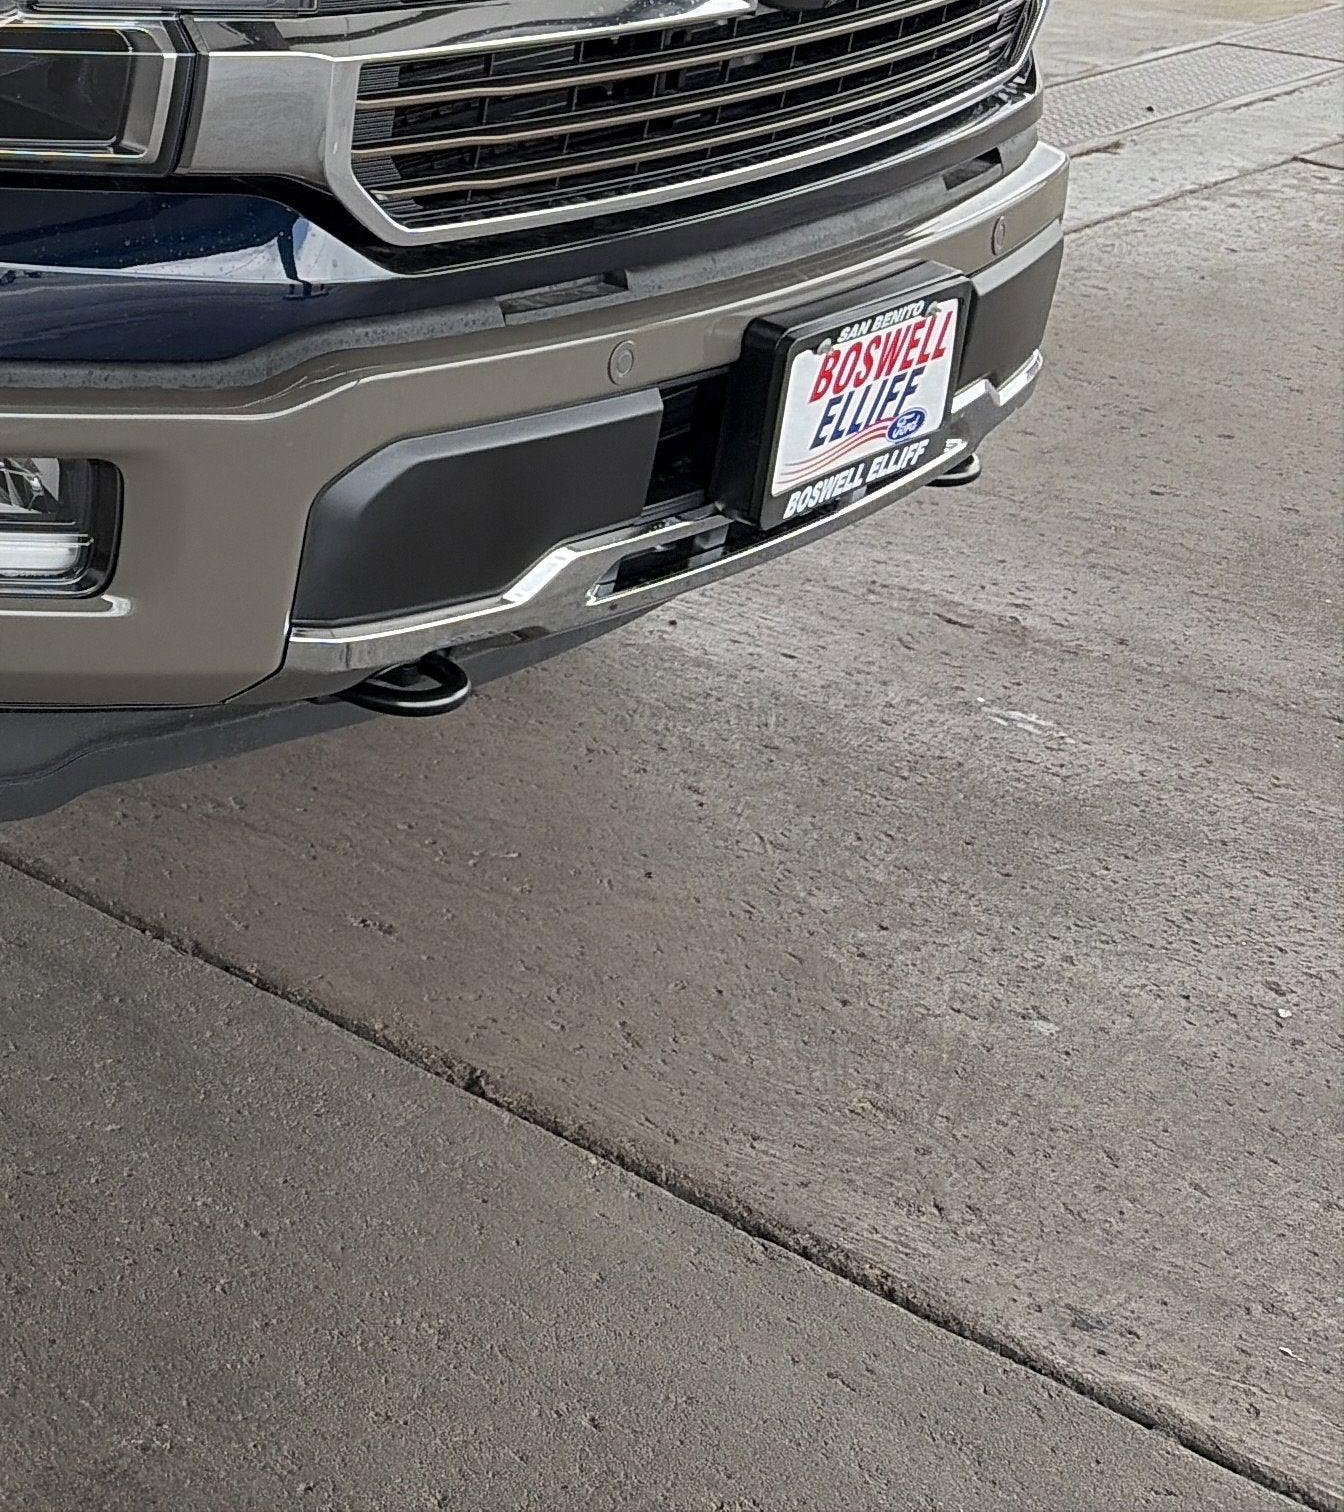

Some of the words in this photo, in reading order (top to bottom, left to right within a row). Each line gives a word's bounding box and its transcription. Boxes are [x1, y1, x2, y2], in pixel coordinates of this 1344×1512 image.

[809, 311, 953, 403] BOSWELL
[837, 321, 870, 343] SAN
[872, 300, 926, 335] BENITO
[809, 367, 926, 450] ELLIFF
[892, 413, 925, 440] Ford
[782, 463, 864, 520] BOSWELL
[866, 439, 928, 484] ELLIFF
